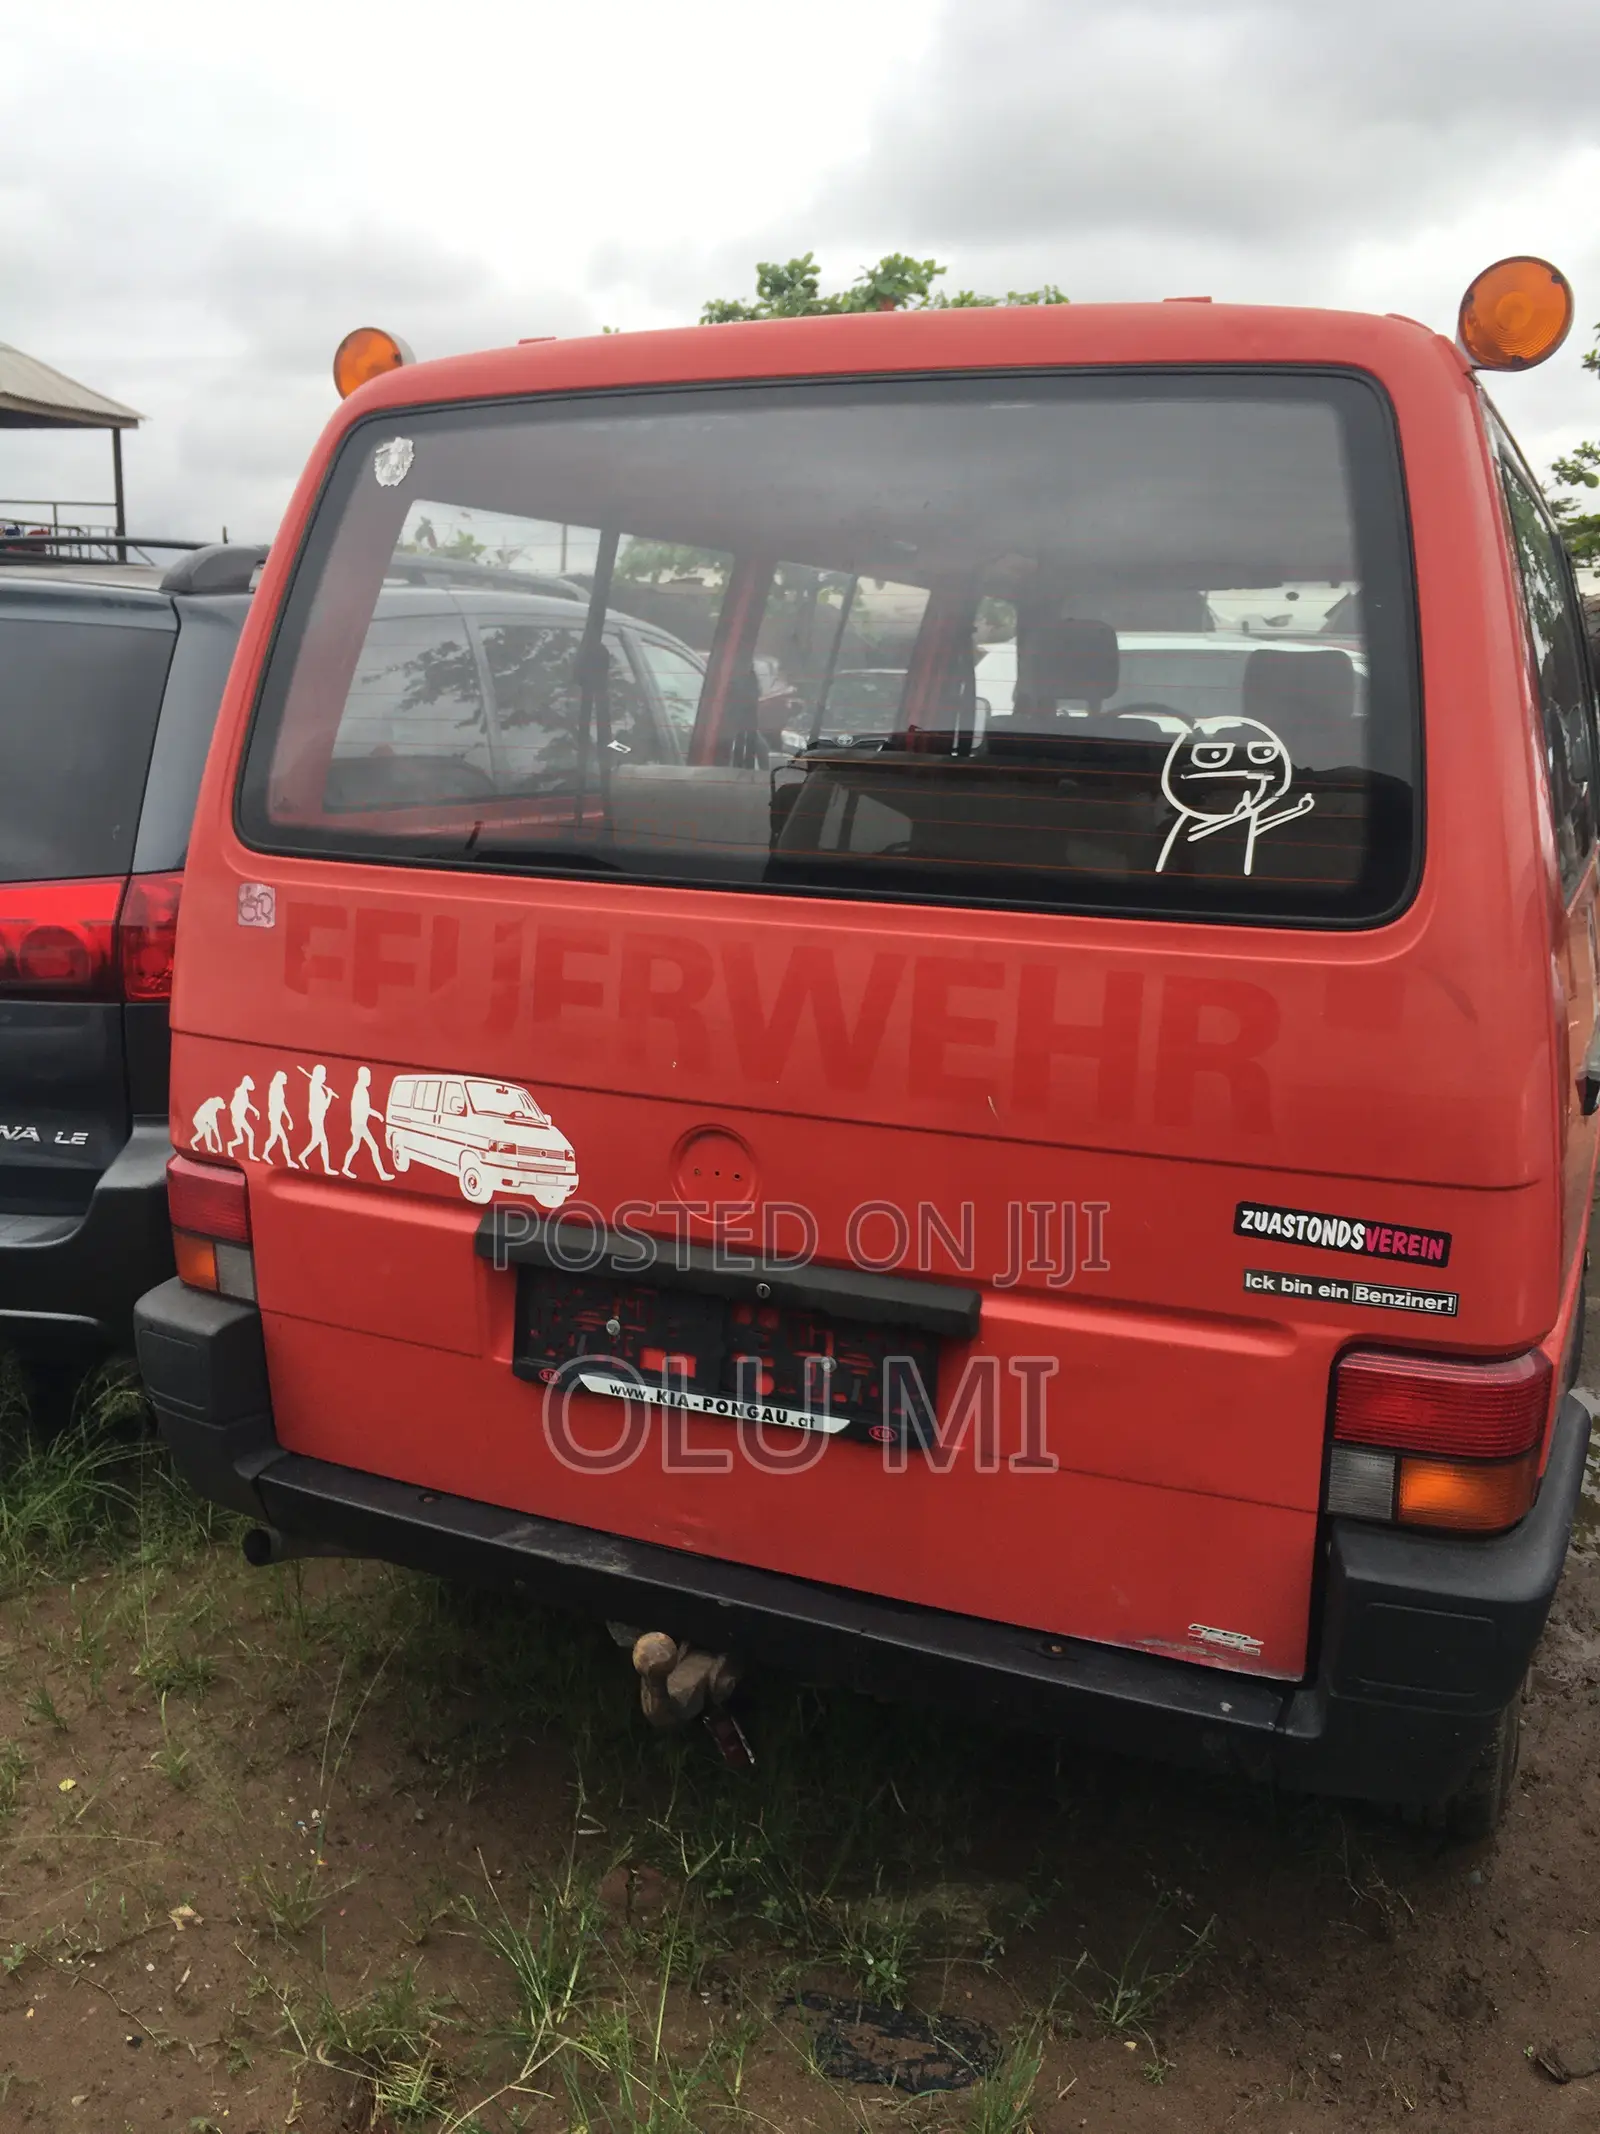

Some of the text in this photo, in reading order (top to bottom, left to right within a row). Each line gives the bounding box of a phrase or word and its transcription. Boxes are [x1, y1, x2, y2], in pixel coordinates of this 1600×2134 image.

[54, 1131, 89, 1145] LE
[1240, 1210, 1445, 1261] ZUASTONDSVEREIN
[1245, 1273, 1454, 1312] Ick bin ein Benziner!
[609, 1383, 816, 1429] www.KIA-PONGAU.at
